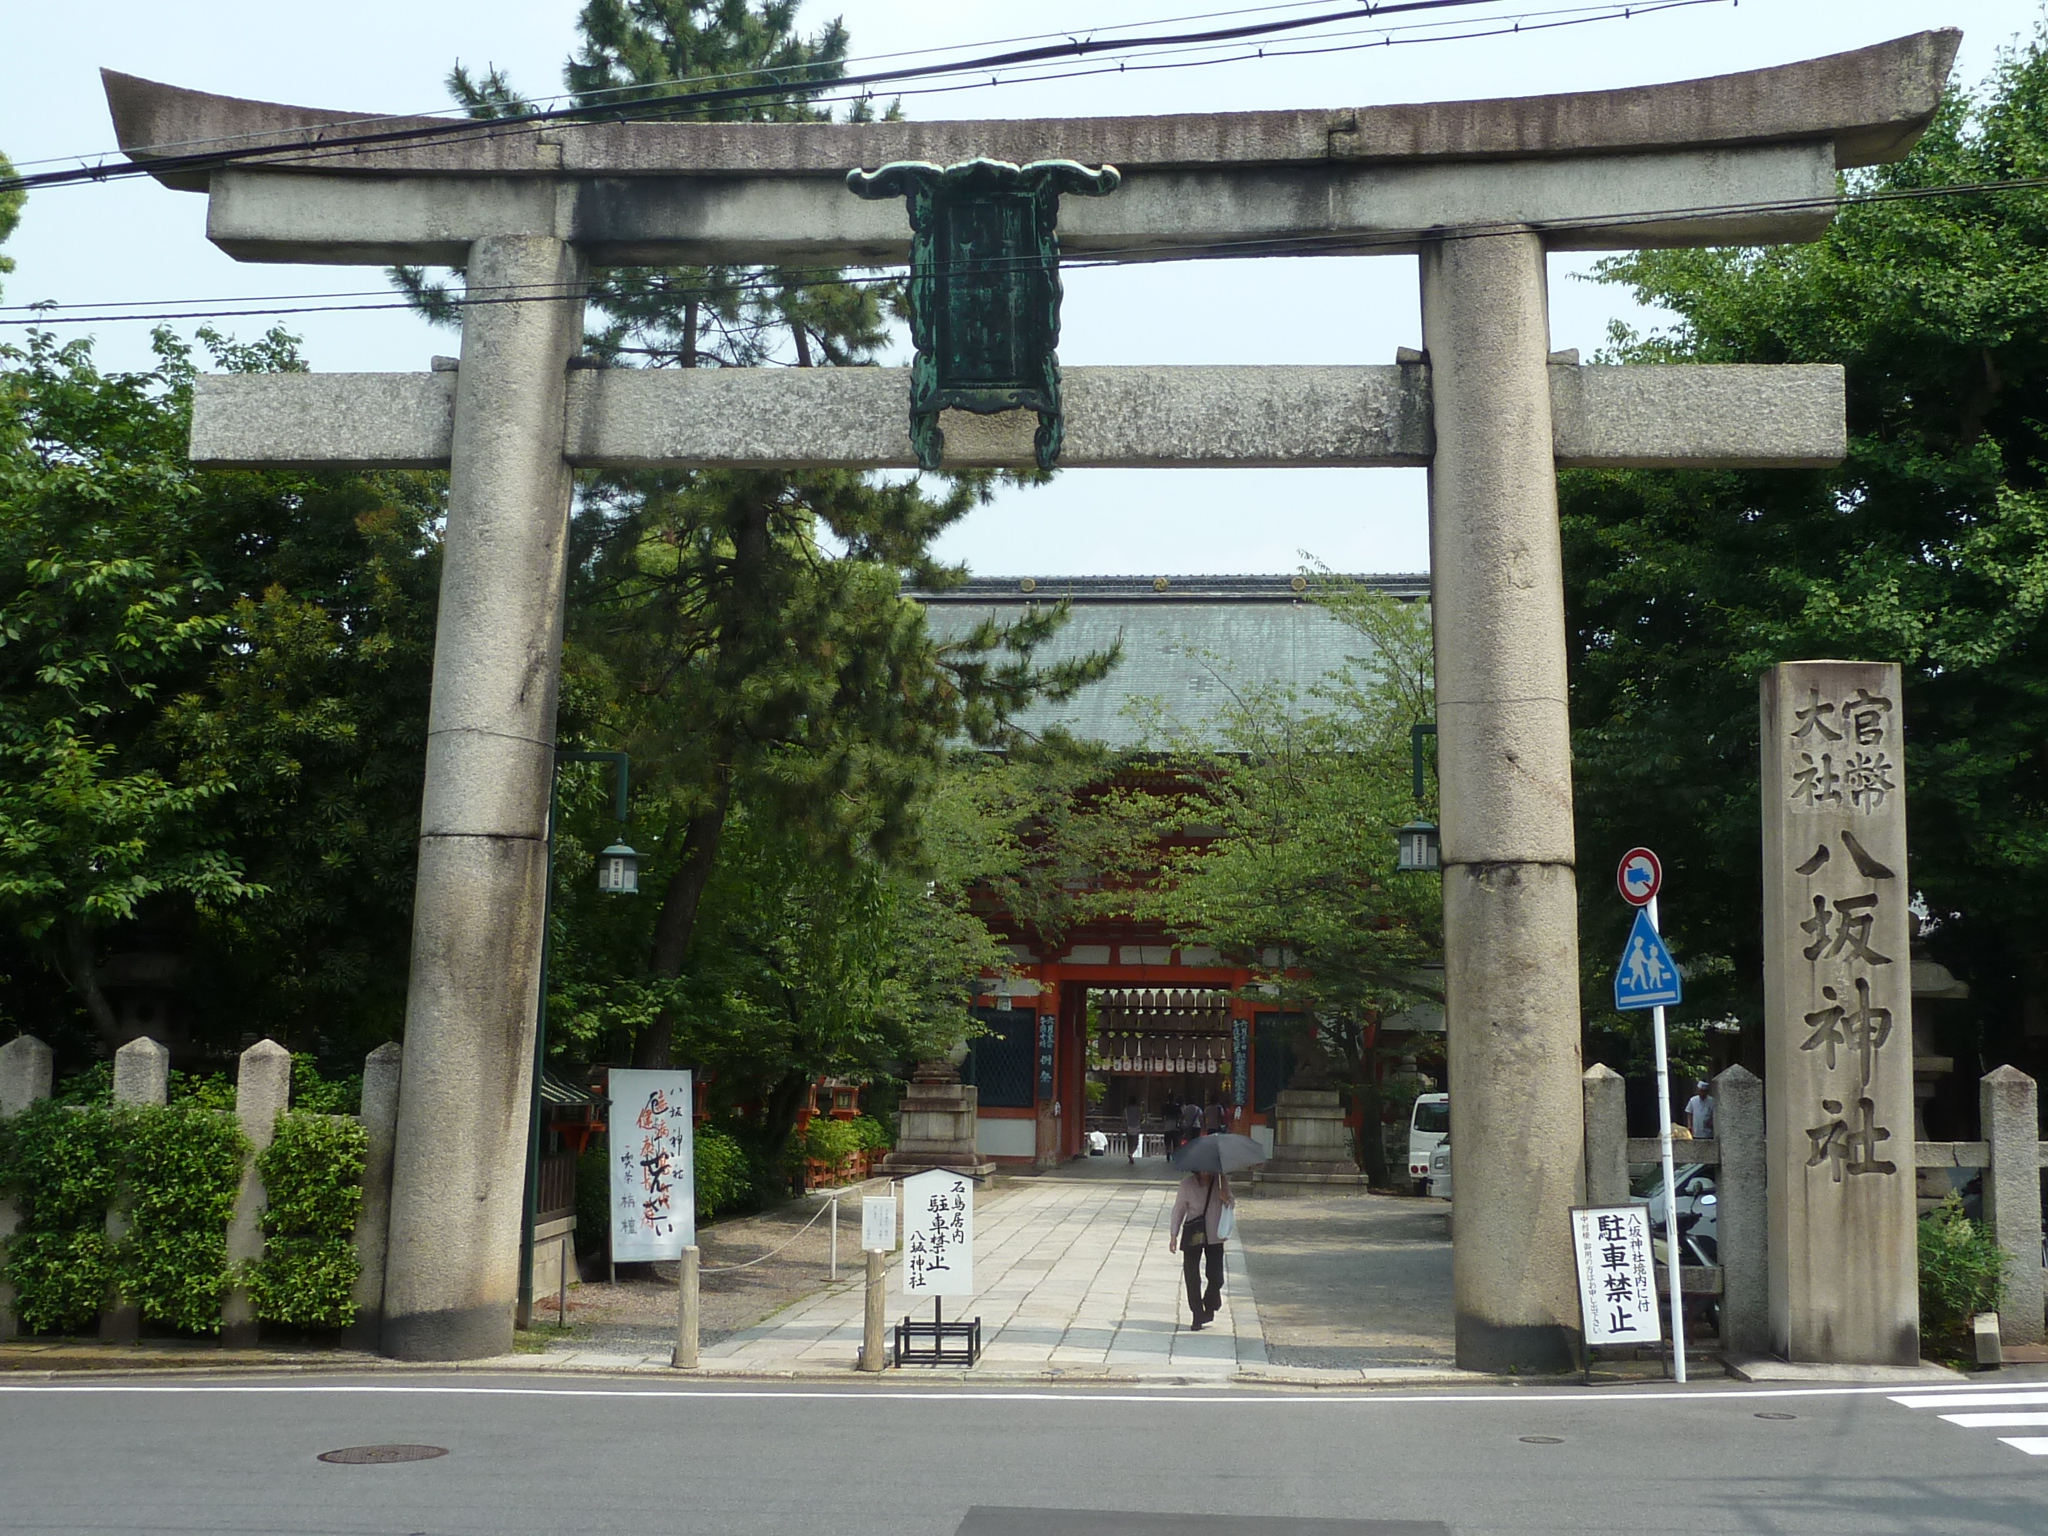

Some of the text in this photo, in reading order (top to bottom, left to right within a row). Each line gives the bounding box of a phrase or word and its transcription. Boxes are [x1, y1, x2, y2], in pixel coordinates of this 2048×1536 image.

[1790, 687, 1843, 806] 大社
[1841, 686, 1896, 816] 官幣
[1795, 828, 1897, 1183] 八坂神社
[668, 1086, 684, 1181] 八坂神社
[909, 1230, 927, 1289] 八坂神社
[926, 1194, 951, 1271] 駐車禁止
[950, 1181, 966, 1245] 石鳥居内
[1627, 1213, 1650, 1312] 八坂神社境内に付
[1597, 1214, 1637, 1334] 駐車禁止
